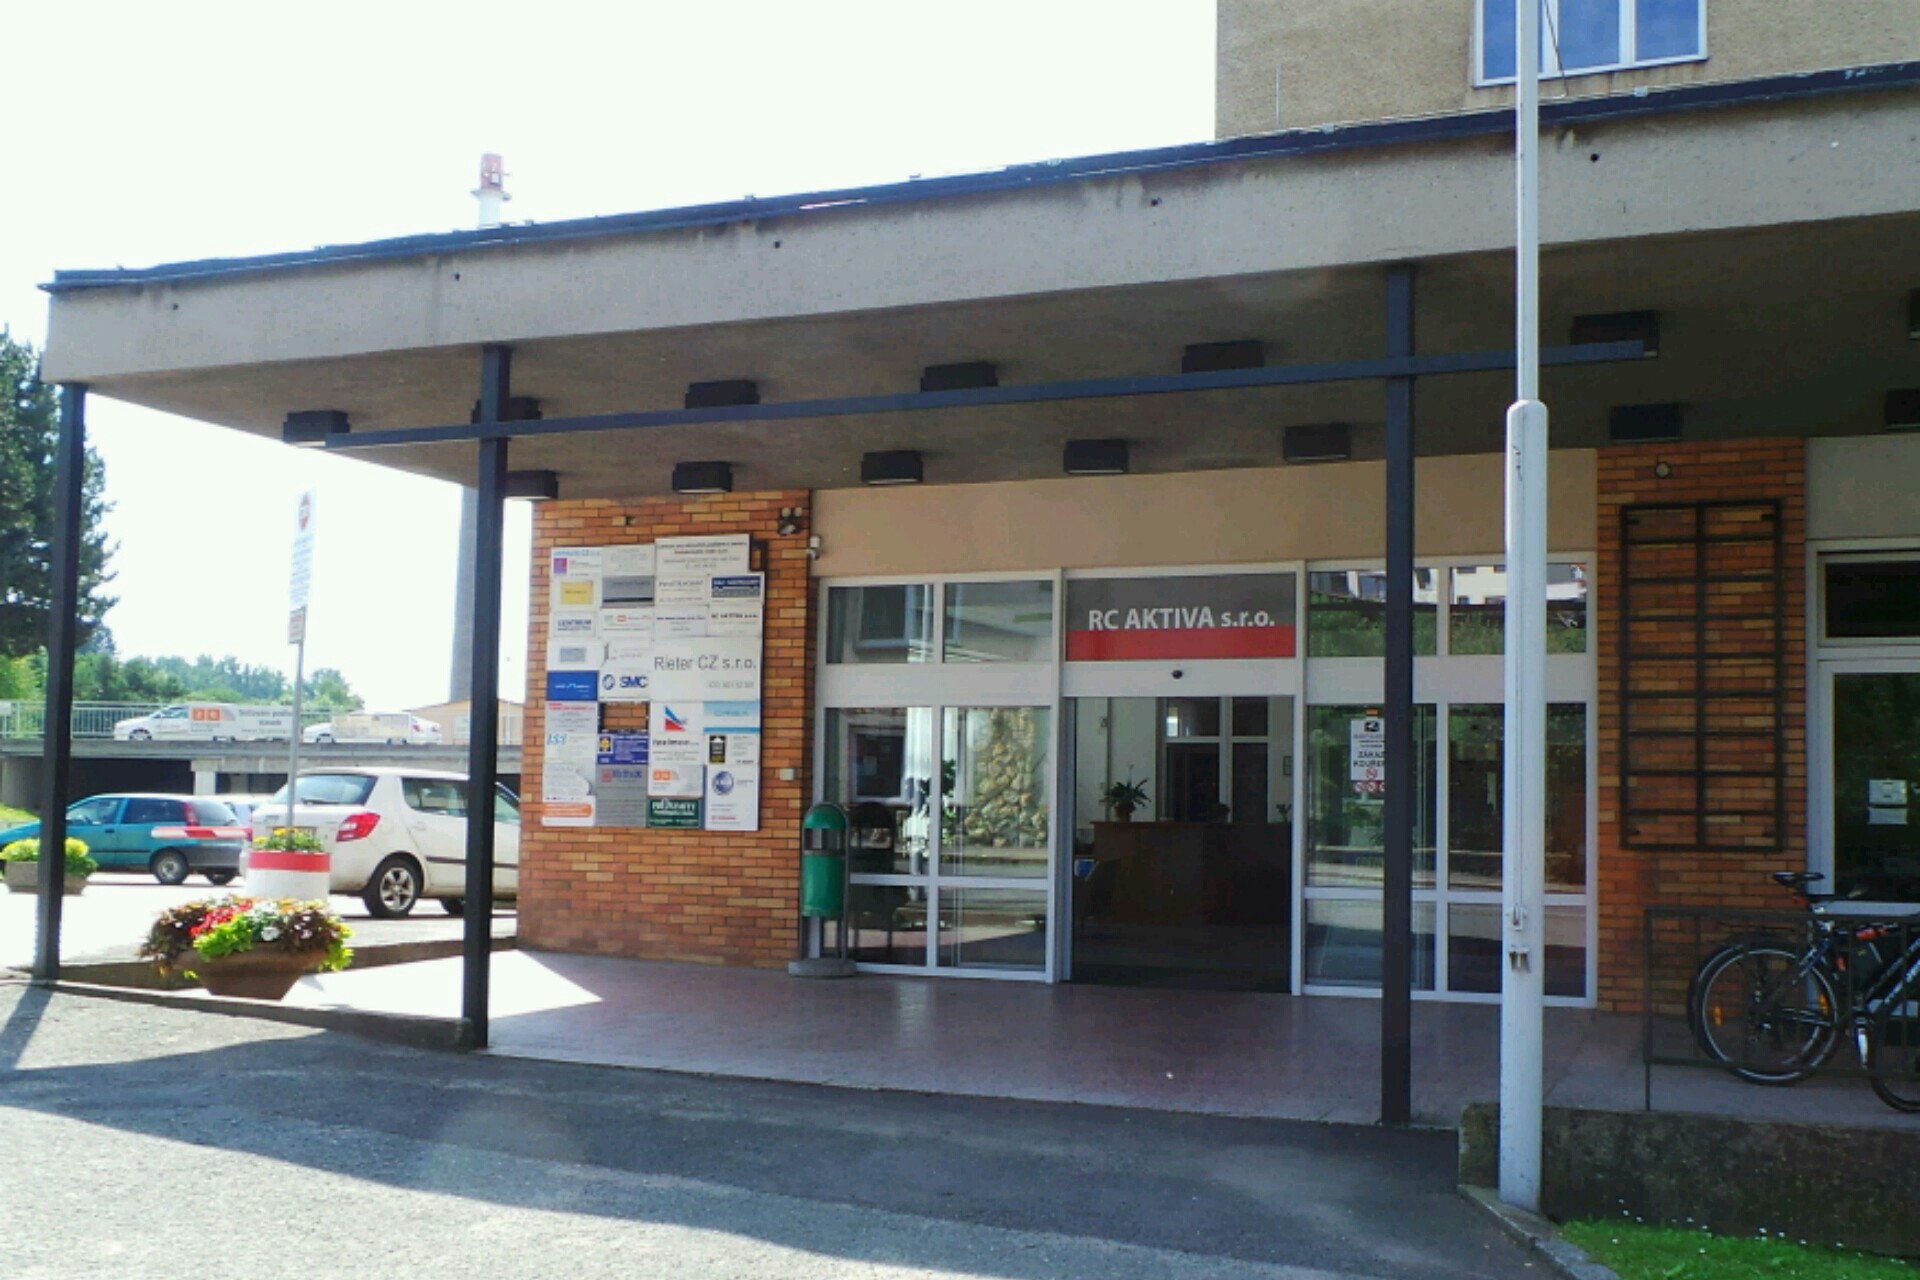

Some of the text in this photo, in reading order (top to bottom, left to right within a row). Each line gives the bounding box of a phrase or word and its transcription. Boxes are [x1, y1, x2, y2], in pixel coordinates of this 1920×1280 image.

[1088, 606, 1275, 631] RC AKTIVA s.r.o.
[654, 654, 757, 671] Rieter CZ s.r.o.
[619, 675, 648, 688] SMC
